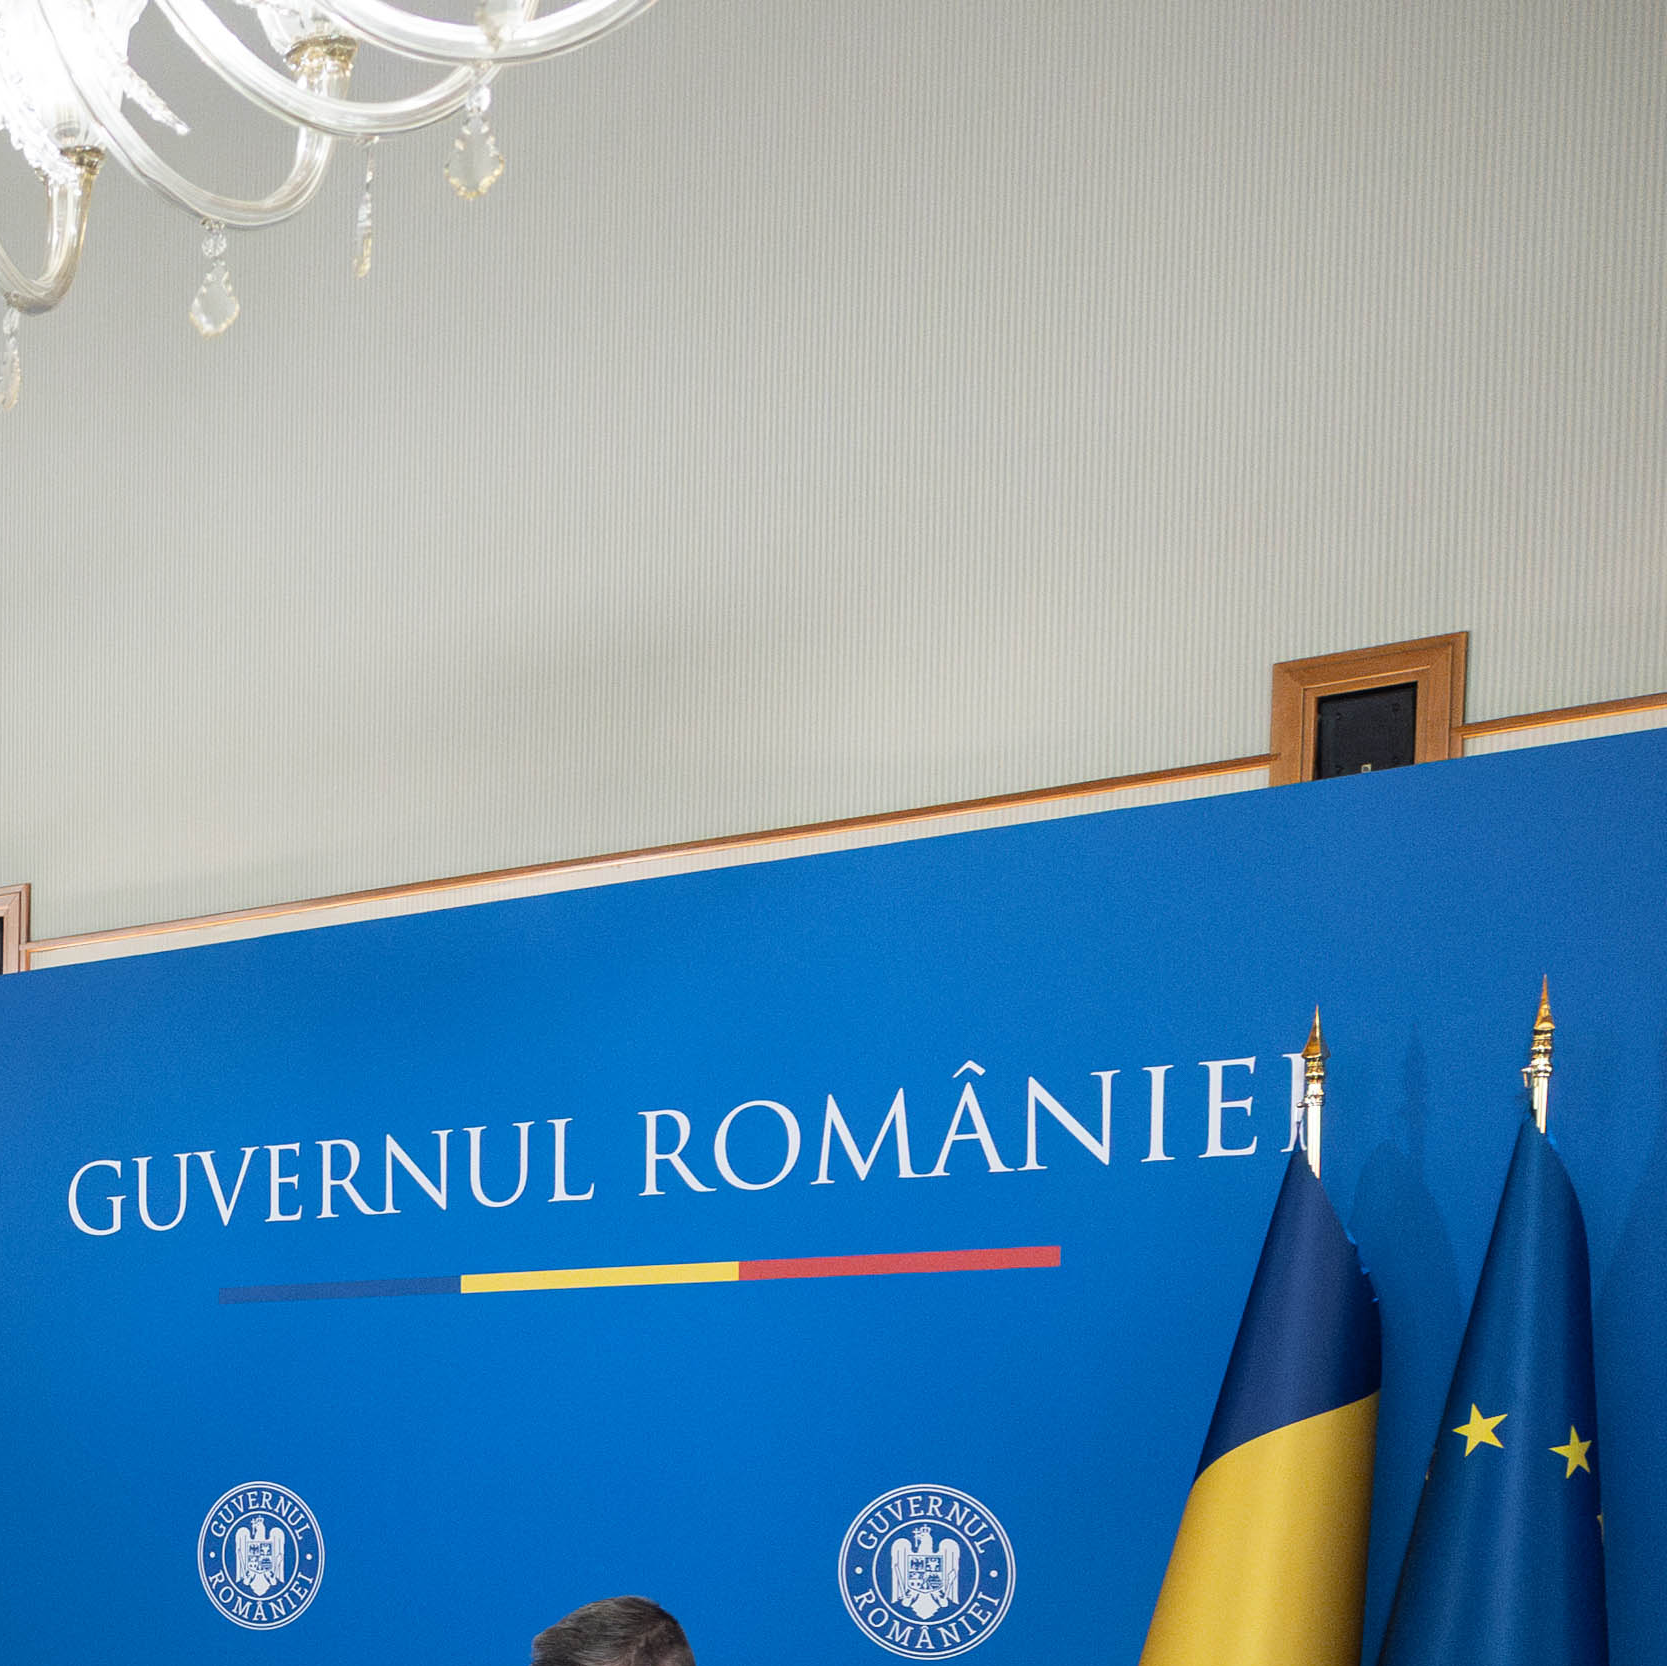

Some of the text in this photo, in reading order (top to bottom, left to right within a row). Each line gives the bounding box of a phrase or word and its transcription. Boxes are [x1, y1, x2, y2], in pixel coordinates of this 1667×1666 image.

[68, 1052, 1307, 1236] GUVERNUL ROMÂNIEI
[210, 1490, 311, 1541] GUVERNUL
[856, 1495, 996, 1554] GUVERNUL
[208, 1569, 314, 1621] ROMÂNIEI
[853, 1588, 1001, 1649] ROMÂNIEI
